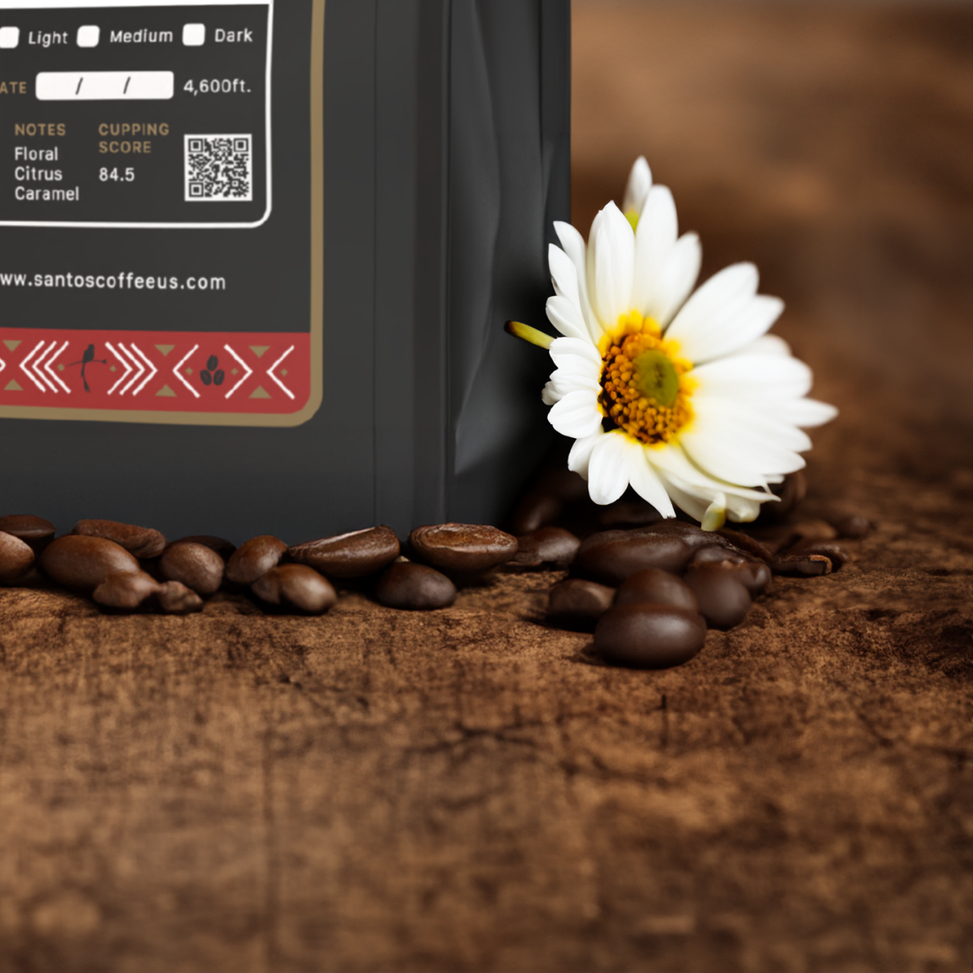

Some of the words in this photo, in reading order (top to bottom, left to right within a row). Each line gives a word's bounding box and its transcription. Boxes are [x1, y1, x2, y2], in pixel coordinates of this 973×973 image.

[29, 31, 68, 48] Light
[110, 29, 173, 43] Medium
[215, 28, 252, 42] Dark
[184, 78, 251, 96] 4,600ft.
[15, 123, 65, 136] NOTES
[98, 123, 169, 136] CUPPING
[15, 147, 58, 161] Floral
[99, 141, 151, 153] SCORE
[15, 166, 62, 181] Citrus
[99, 167, 134, 181] 84.5
[15, 186, 79, 201] Caramel
